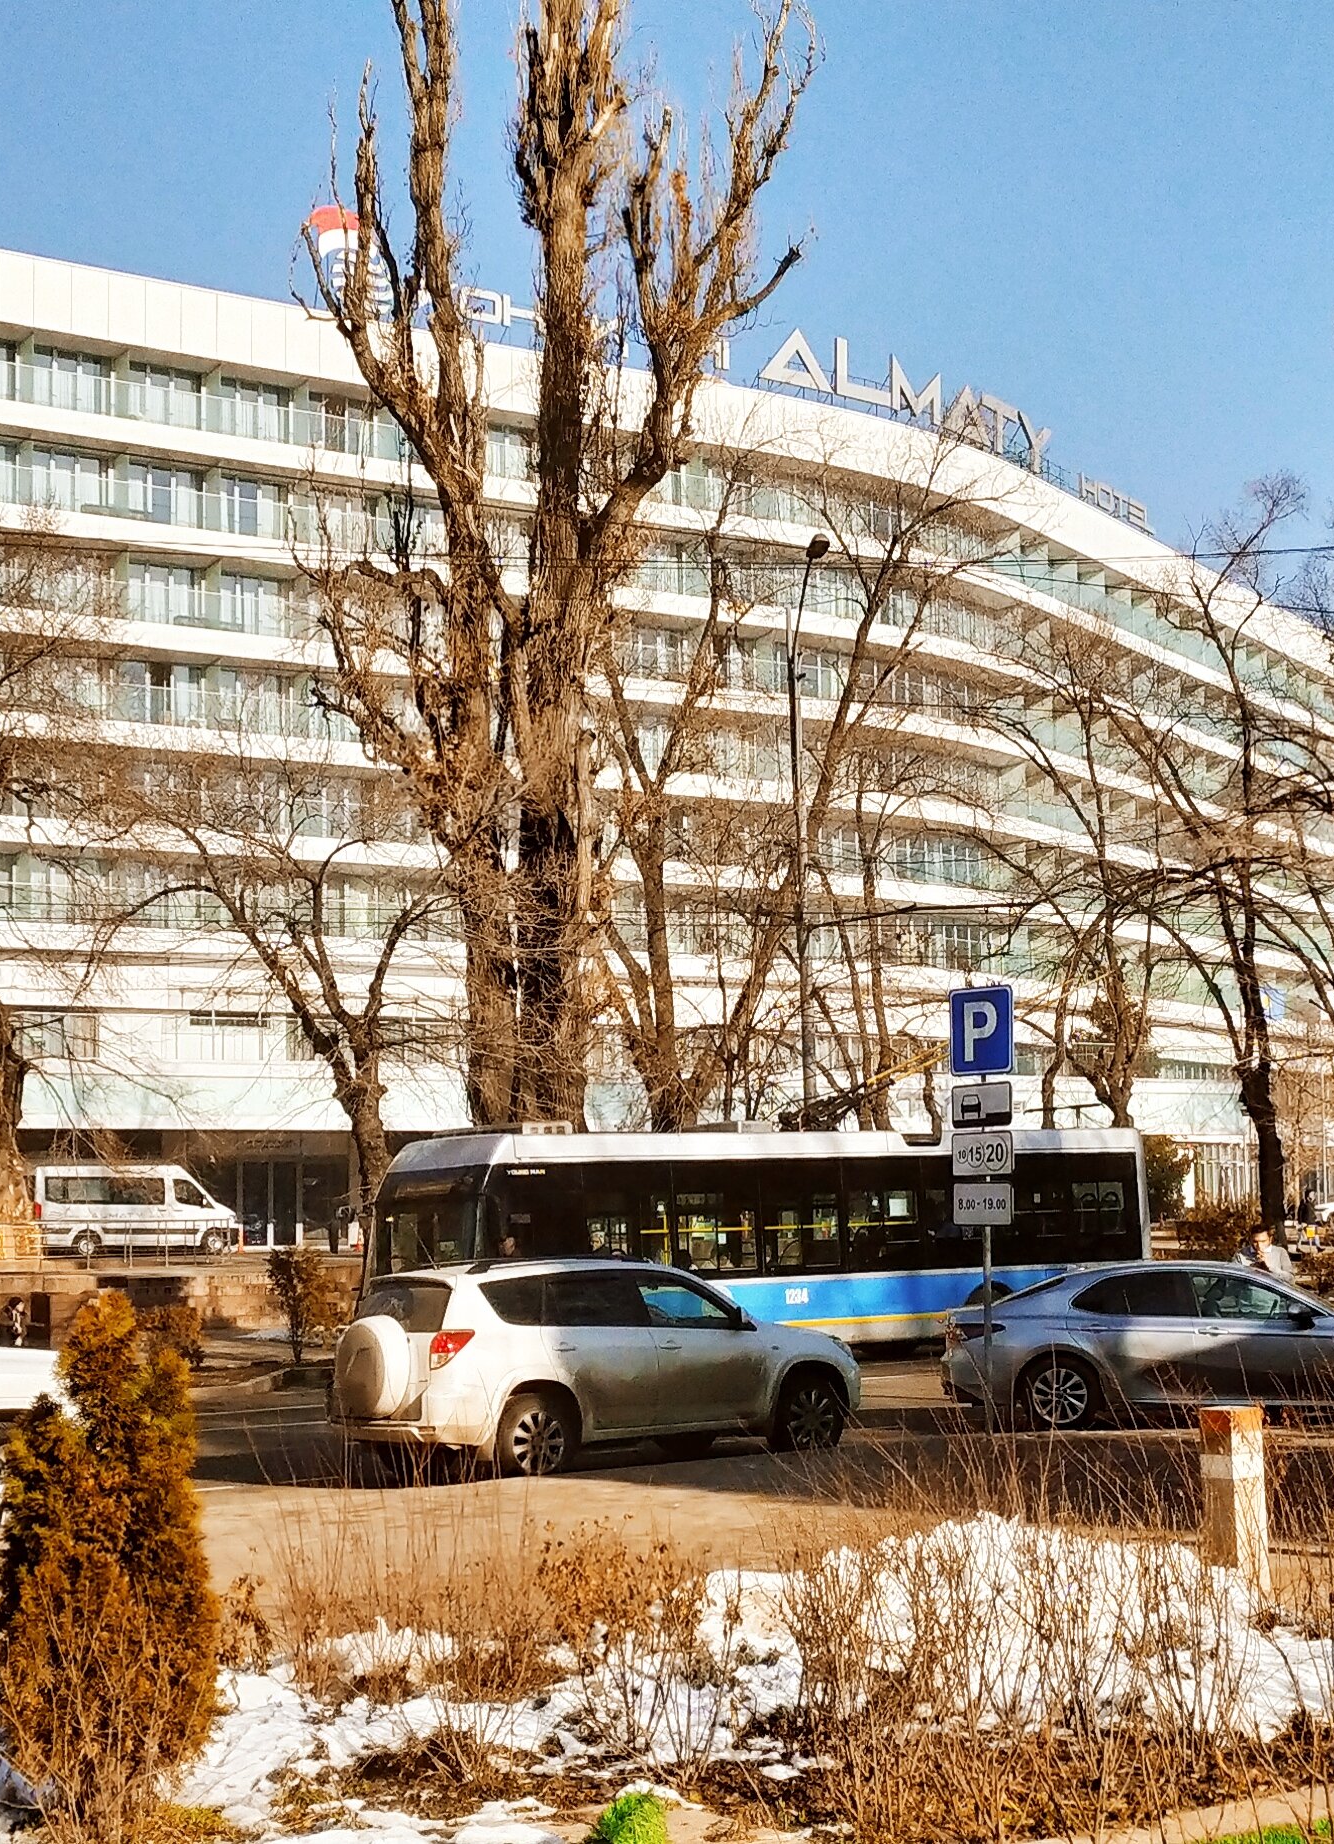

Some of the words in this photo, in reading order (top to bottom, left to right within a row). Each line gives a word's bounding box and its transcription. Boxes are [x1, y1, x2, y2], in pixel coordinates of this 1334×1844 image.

[759, 328, 1052, 474] ALMATY
[964, 1001, 997, 1061] P
[958, 1149, 966, 1159] 10
[969, 1145, 982, 1162] 15
[986, 1143, 1004, 1162] 20
